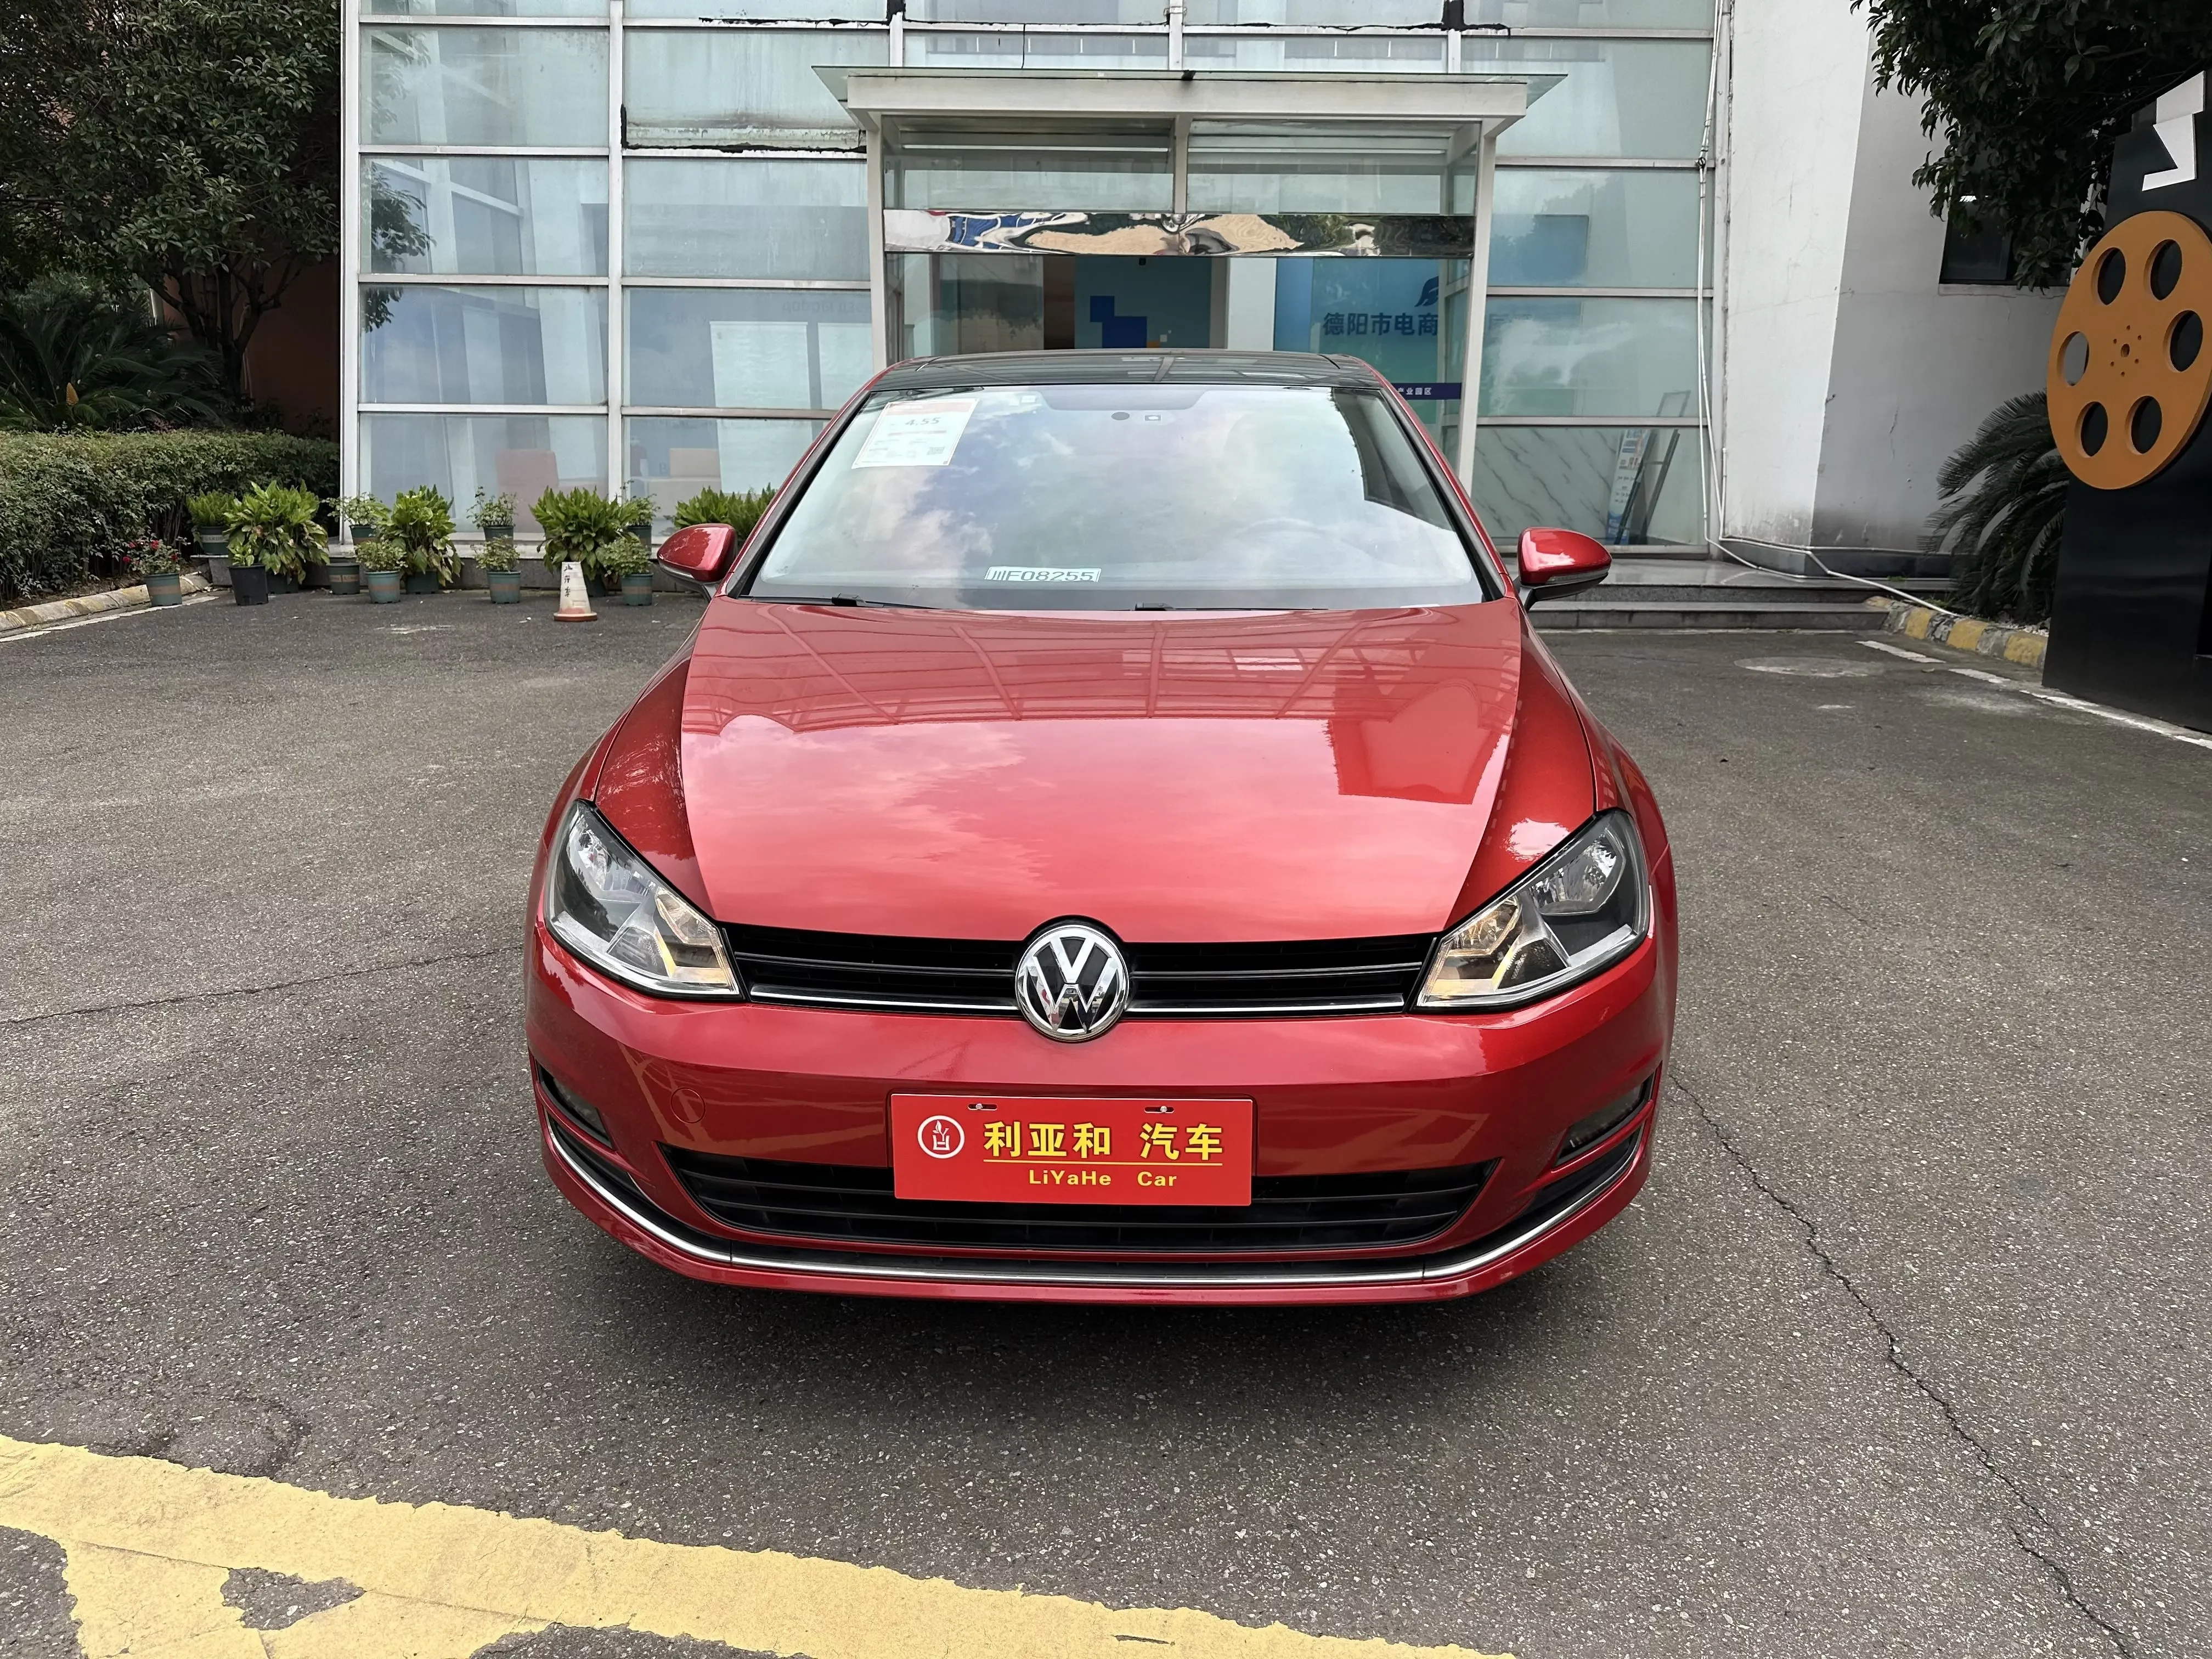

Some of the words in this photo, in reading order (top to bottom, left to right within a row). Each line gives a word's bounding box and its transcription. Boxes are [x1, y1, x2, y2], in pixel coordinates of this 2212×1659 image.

[1323, 312, 1438, 336] 德阳市电商
[905, 417, 941, 426] 4.55
[983, 1121, 1111, 1159] 利亚和
[1139, 1122, 1223, 1161] 汽车
[1028, 1169, 1111, 1186] LiYaHe
[1137, 1170, 1177, 1187] Car
